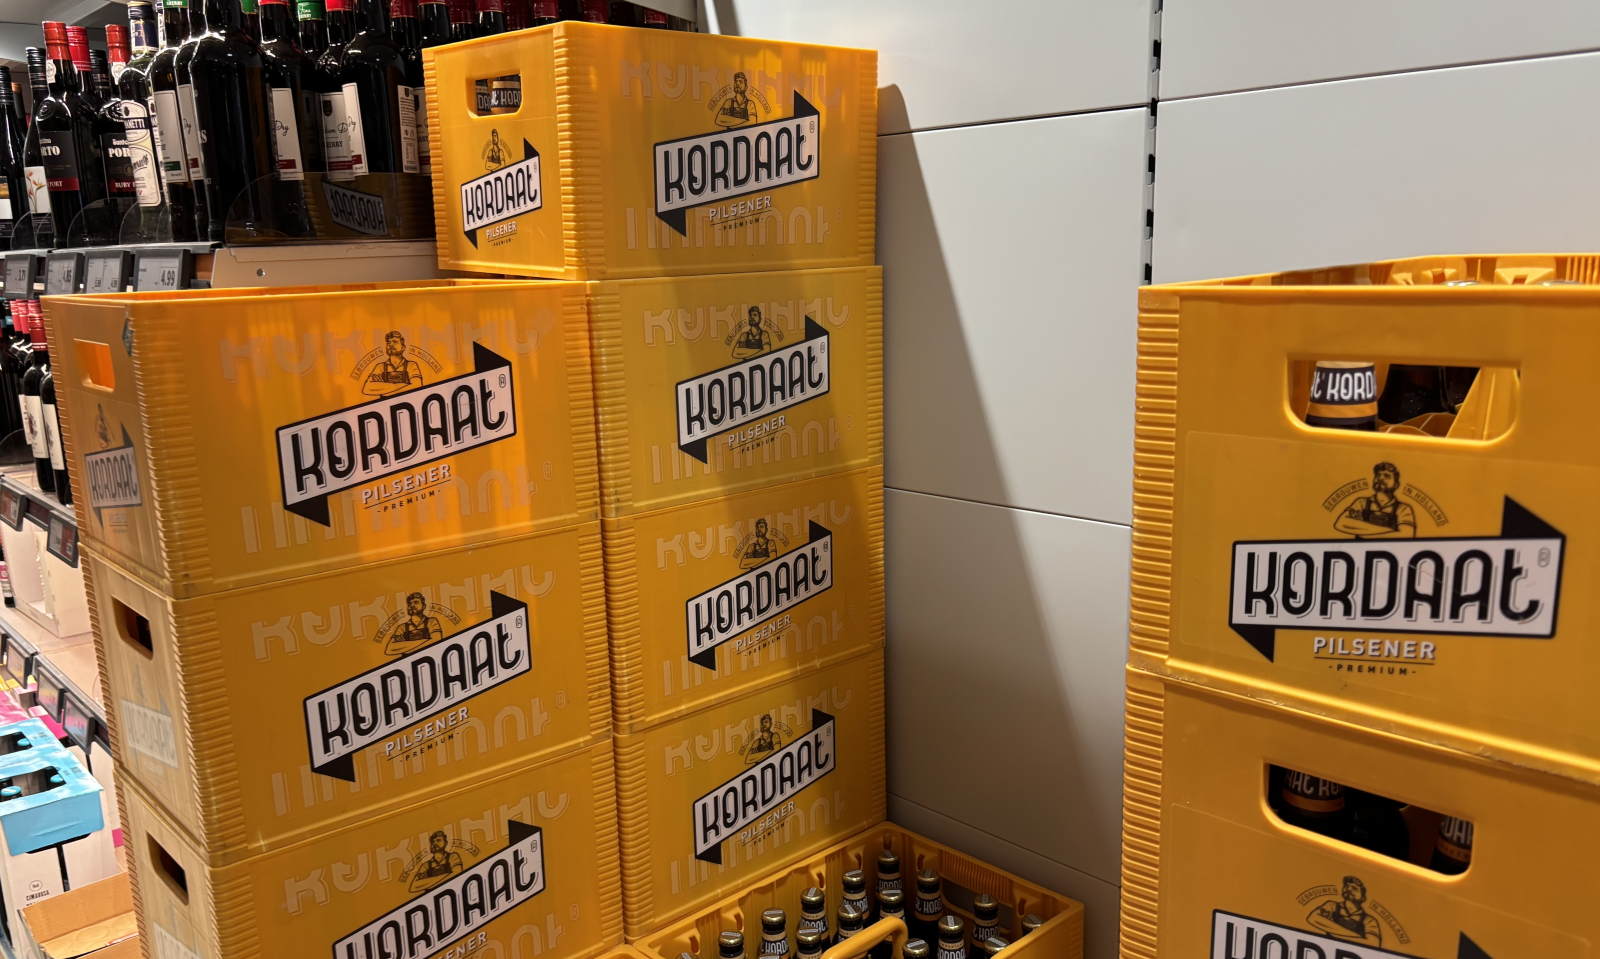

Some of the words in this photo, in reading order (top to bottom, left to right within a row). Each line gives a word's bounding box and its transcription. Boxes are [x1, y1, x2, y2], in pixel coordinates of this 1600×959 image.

[709, 195, 773, 222] PILSENER
[486, 221, 518, 240] PILSENER
[728, 415, 786, 447] PILSENER
[361, 463, 452, 504] PILSENER
[1323, 480, 1369, 511] GEBROUWEN
[1413, 492, 1448, 527] HOLLAND
[736, 614, 791, 651] PILSENER
[1313, 636, 1437, 660] PILSENER
[385, 706, 469, 757] PILSENER
[741, 801, 796, 843] PILSENER
[1297, 887, 1338, 906] GEBROUWEN
